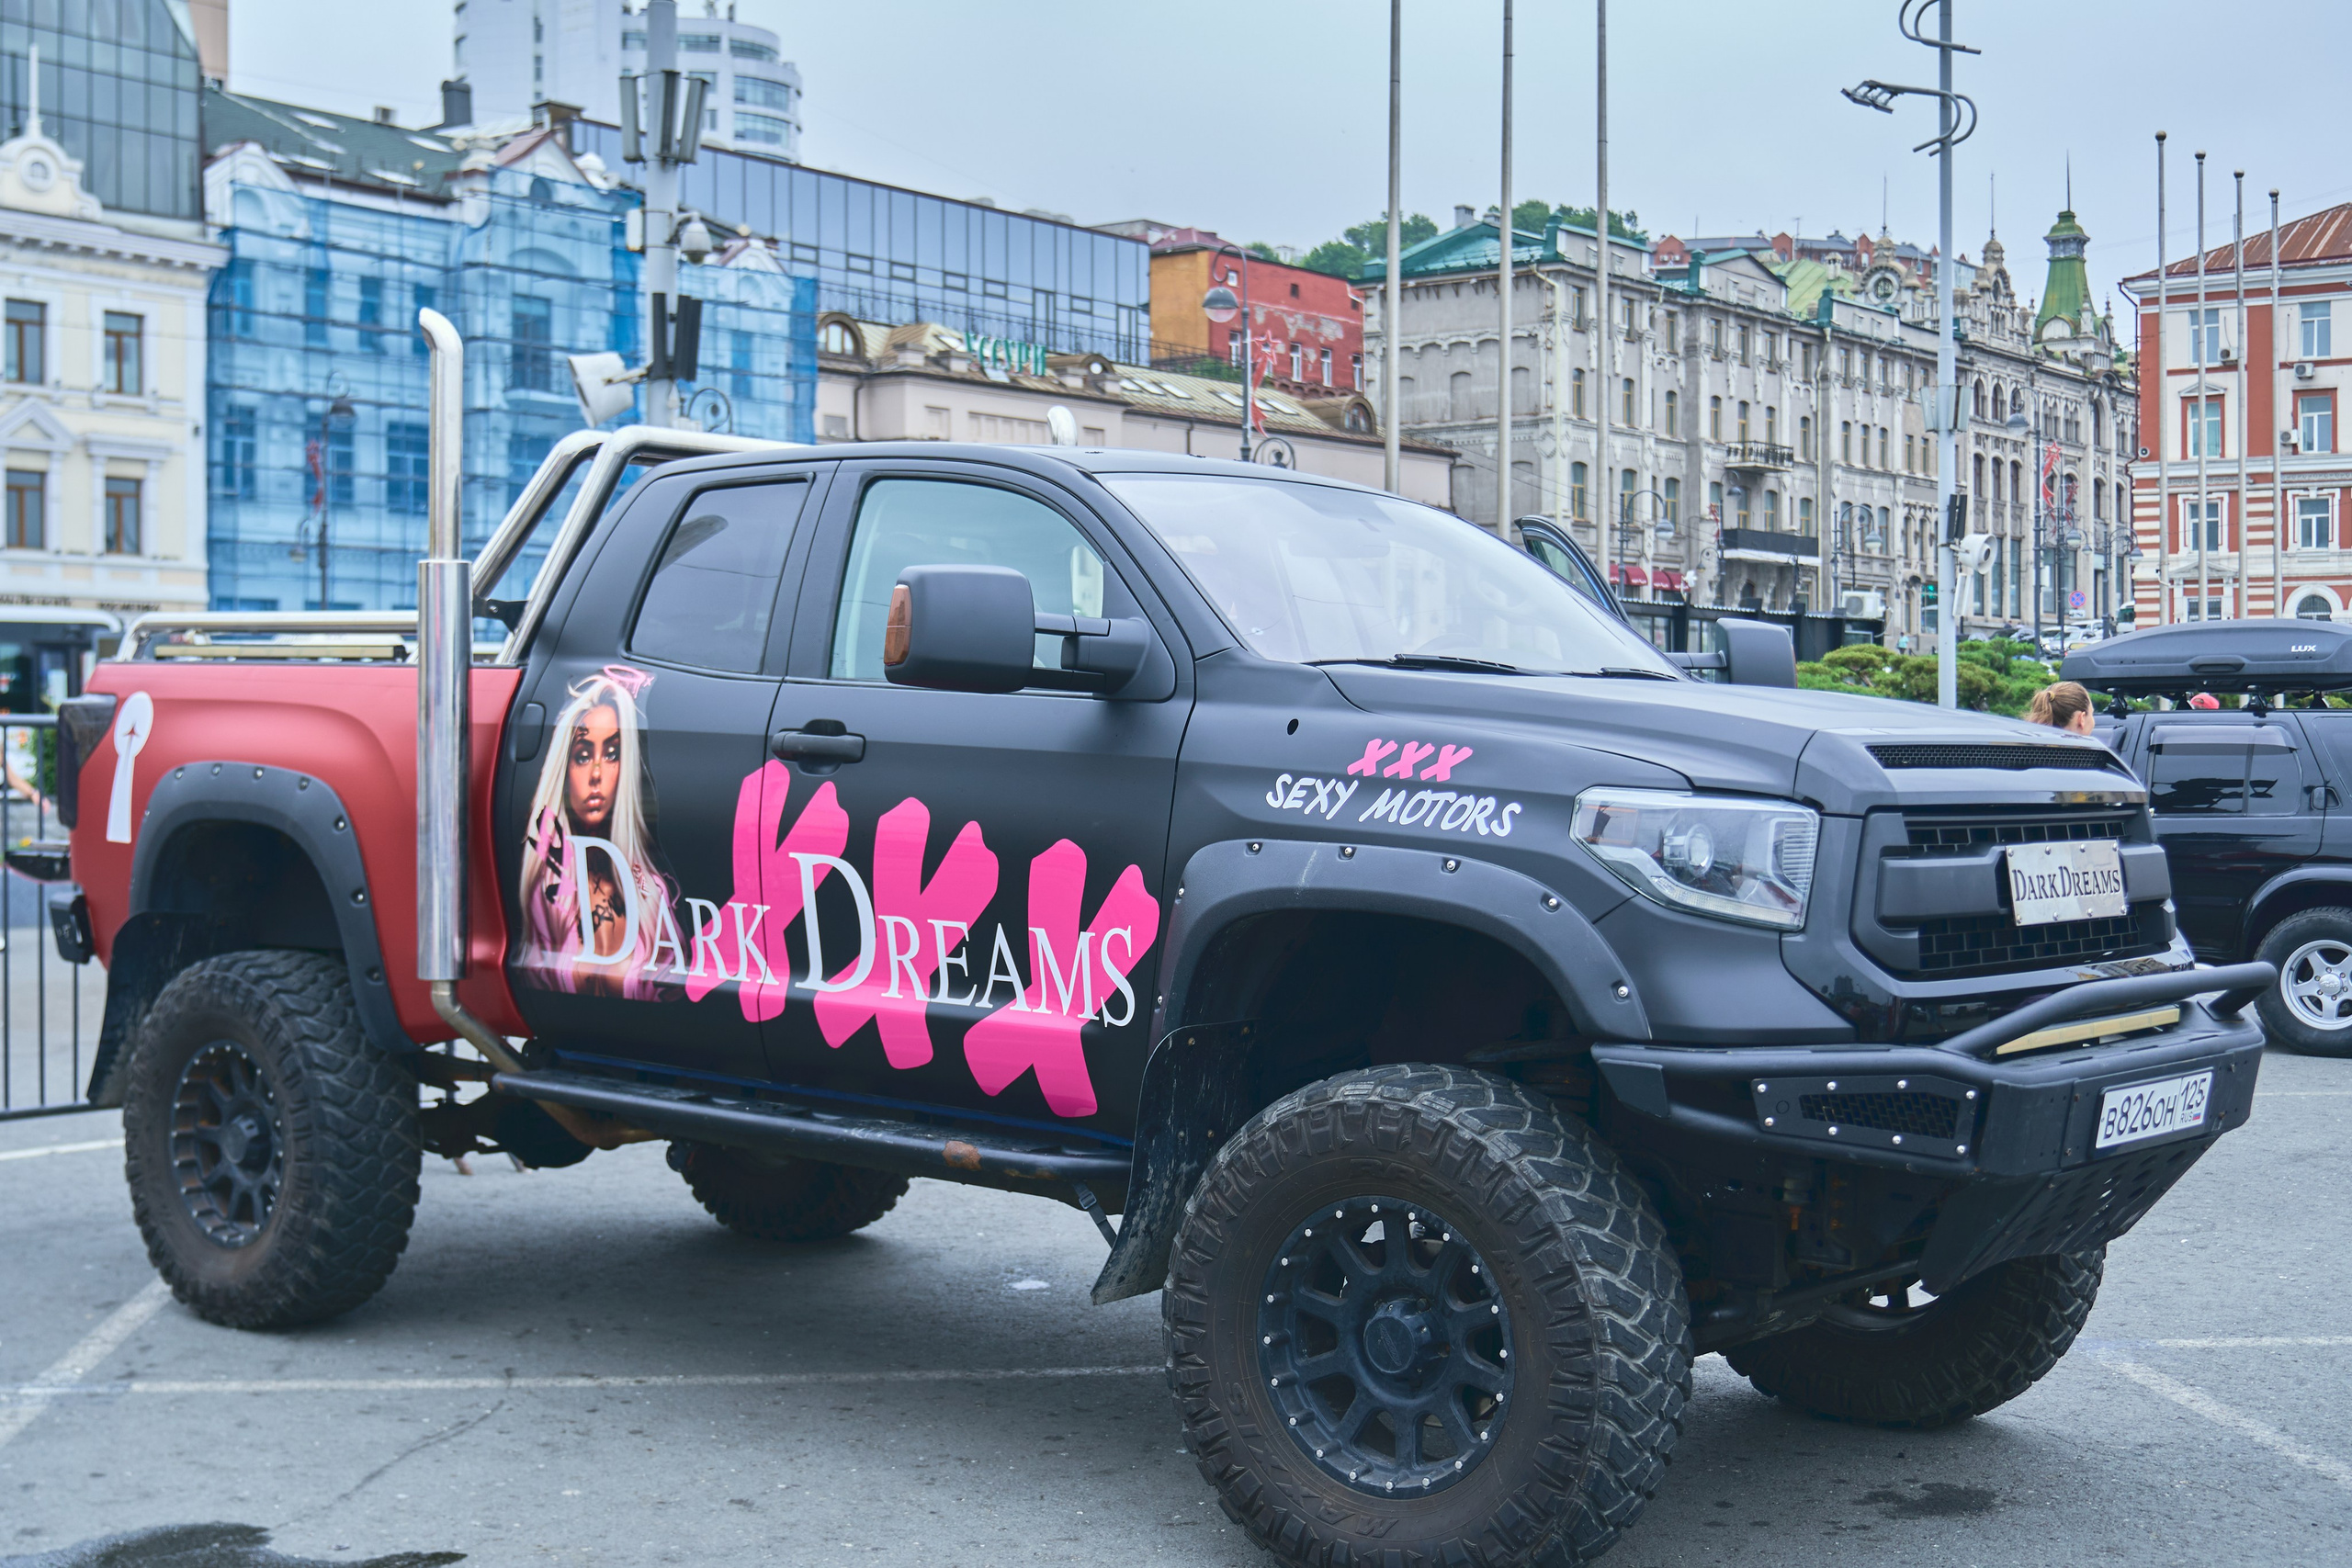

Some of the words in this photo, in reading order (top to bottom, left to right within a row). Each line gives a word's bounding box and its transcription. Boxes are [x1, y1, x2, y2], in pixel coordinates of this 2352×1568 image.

[2290, 644, 2317, 653] LUX
[1266, 774, 1358, 820] SEXY
[1359, 788, 1521, 837] MOTORS
[2103, 1089, 2177, 1140] В826ОН
[2181, 1077, 2207, 1111] 125
[2180, 1111, 2193, 1124] RUS
[1223, 1381, 1400, 1538] MAXXIS
